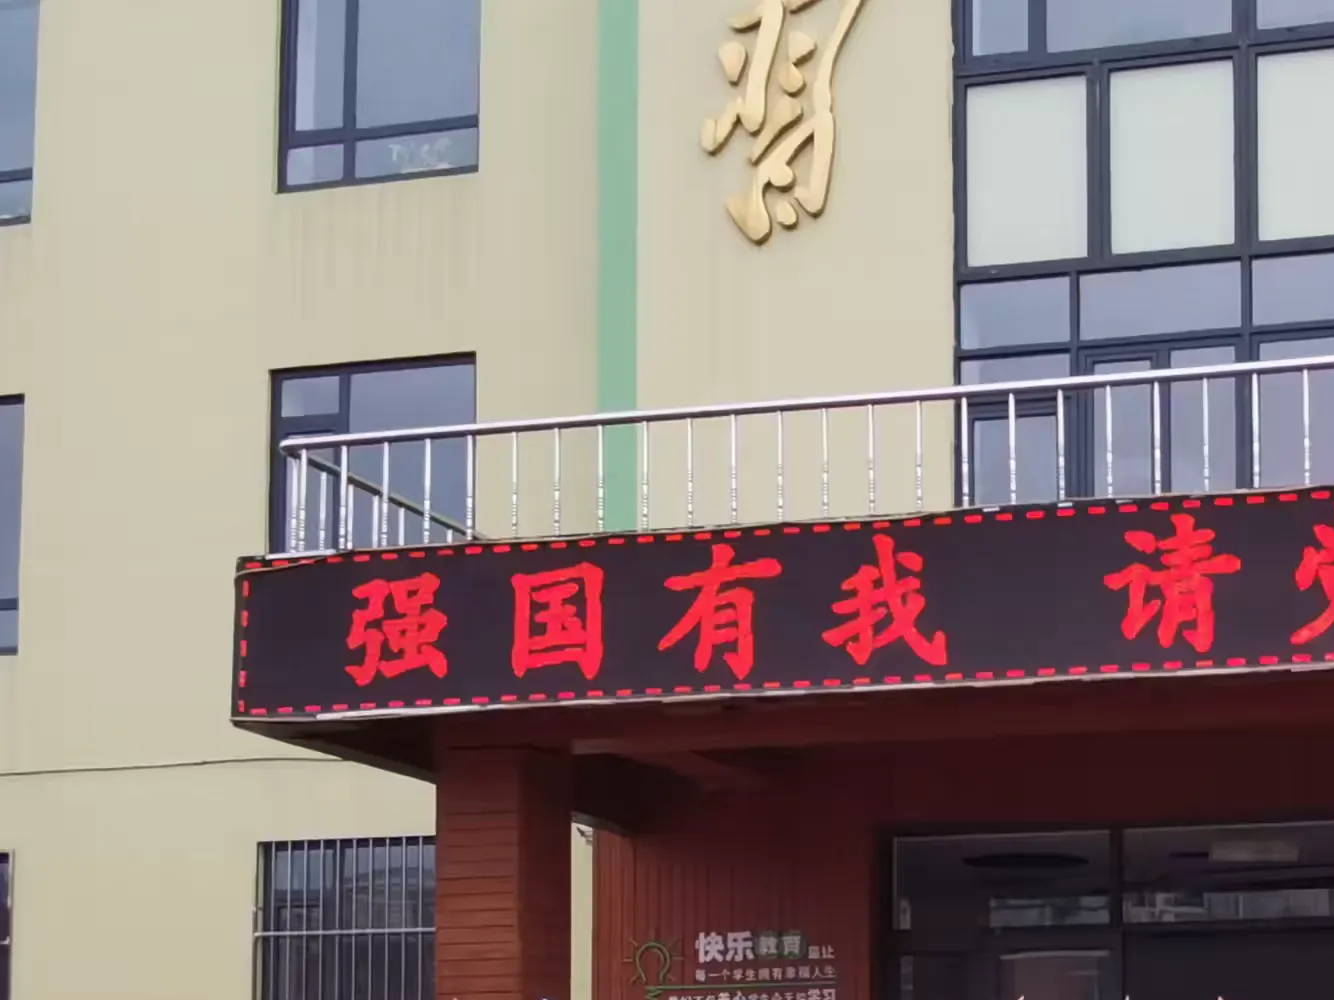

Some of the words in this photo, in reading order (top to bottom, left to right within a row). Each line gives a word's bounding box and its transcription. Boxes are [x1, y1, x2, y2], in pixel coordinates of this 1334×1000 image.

[345, 534, 947, 686] 强国有我
[695, 931, 802, 963] 快乐教育
